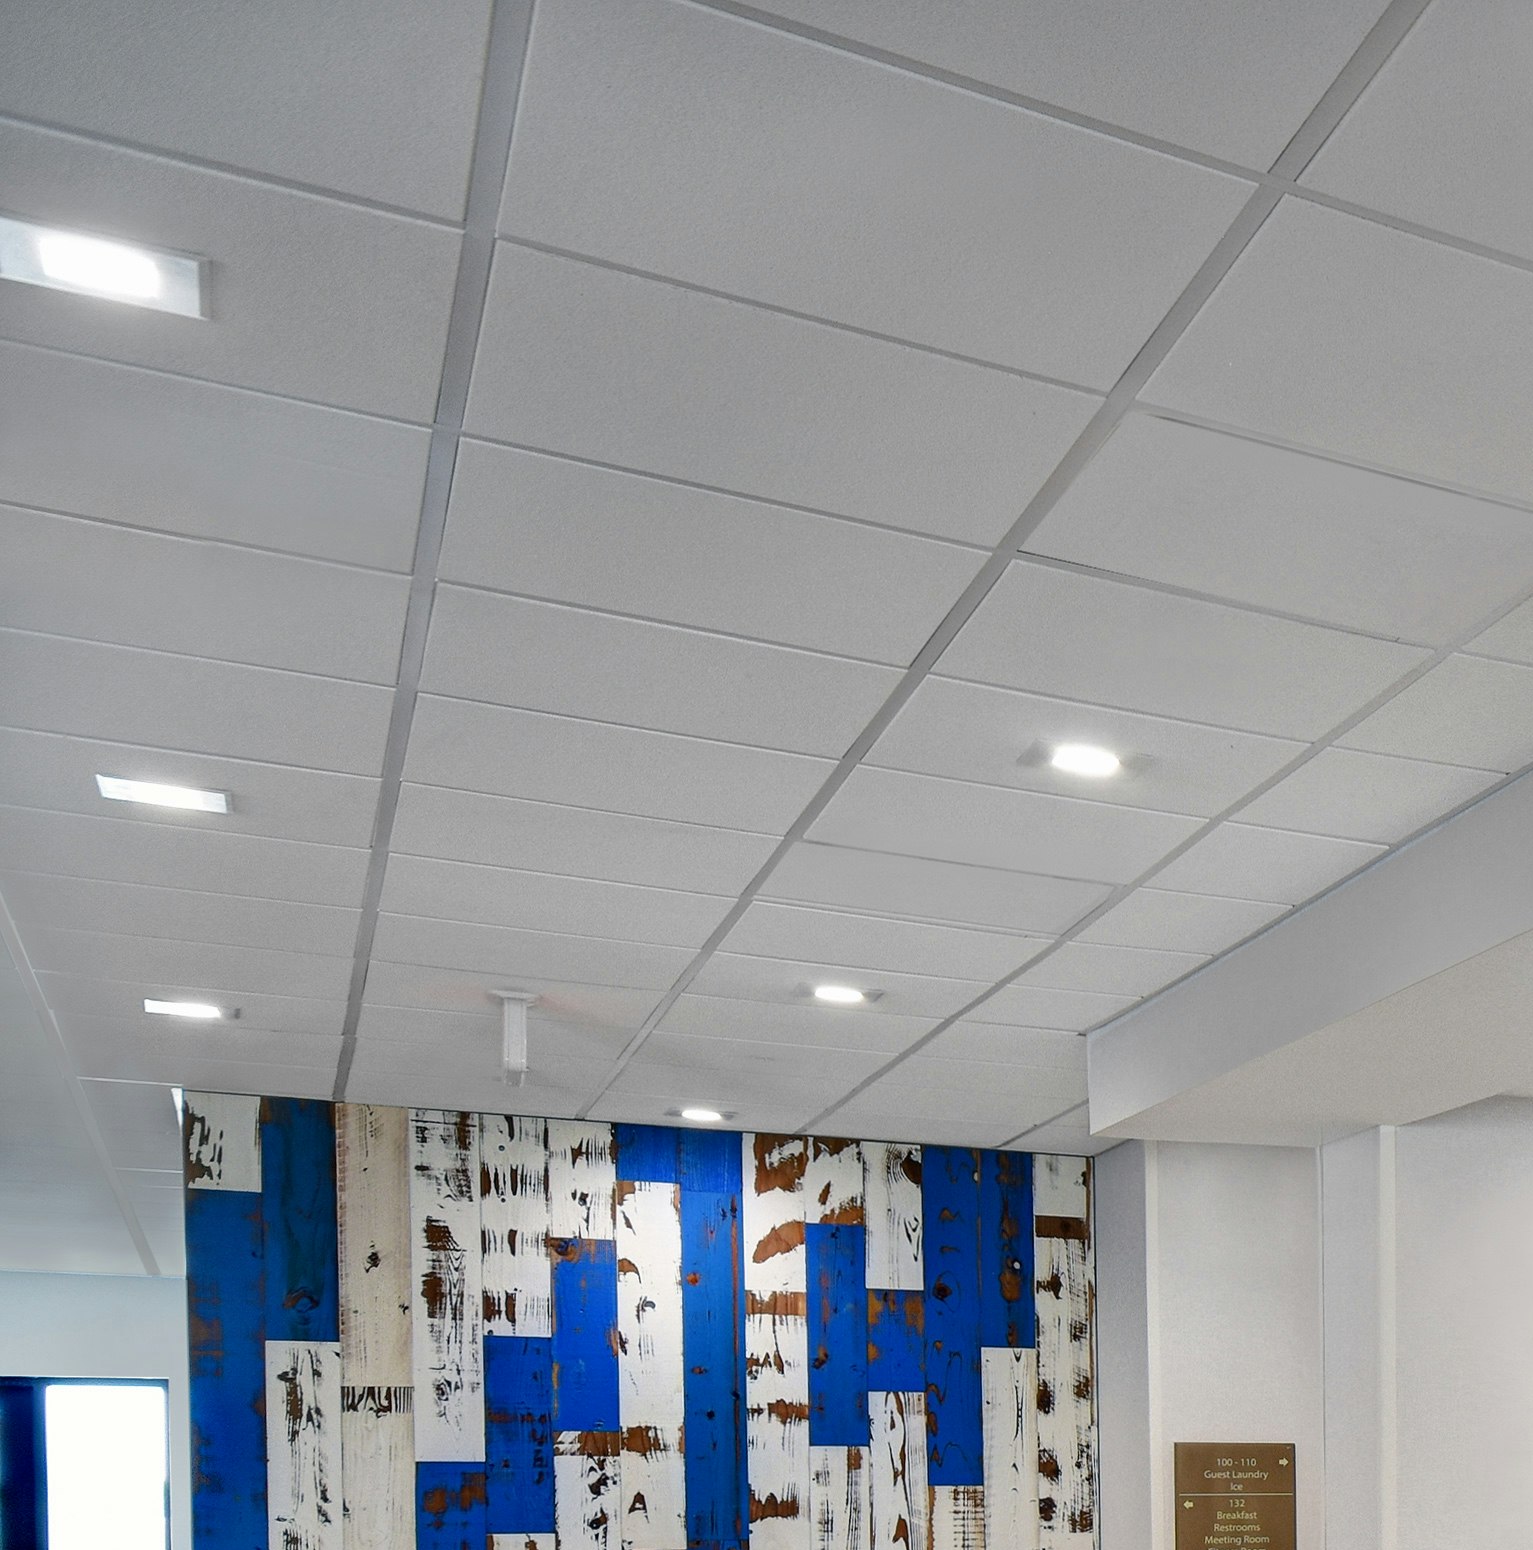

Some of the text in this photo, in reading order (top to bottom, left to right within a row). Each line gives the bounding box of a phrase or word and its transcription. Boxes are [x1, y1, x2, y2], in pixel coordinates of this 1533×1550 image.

[1217, 1458, 1233, 1467] 100
[1241, 1458, 1257, 1467] 110
[1204, 1470, 1269, 1480] Guest Laundry
[1230, 1482, 1244, 1491] Ice
[1230, 1499, 1246, 1508] 132
[1216, 1511, 1258, 1520] Breakfast
[1213, 1523, 1261, 1532] Restrooms
[1204, 1535, 1270, 1546] Meeting Room
